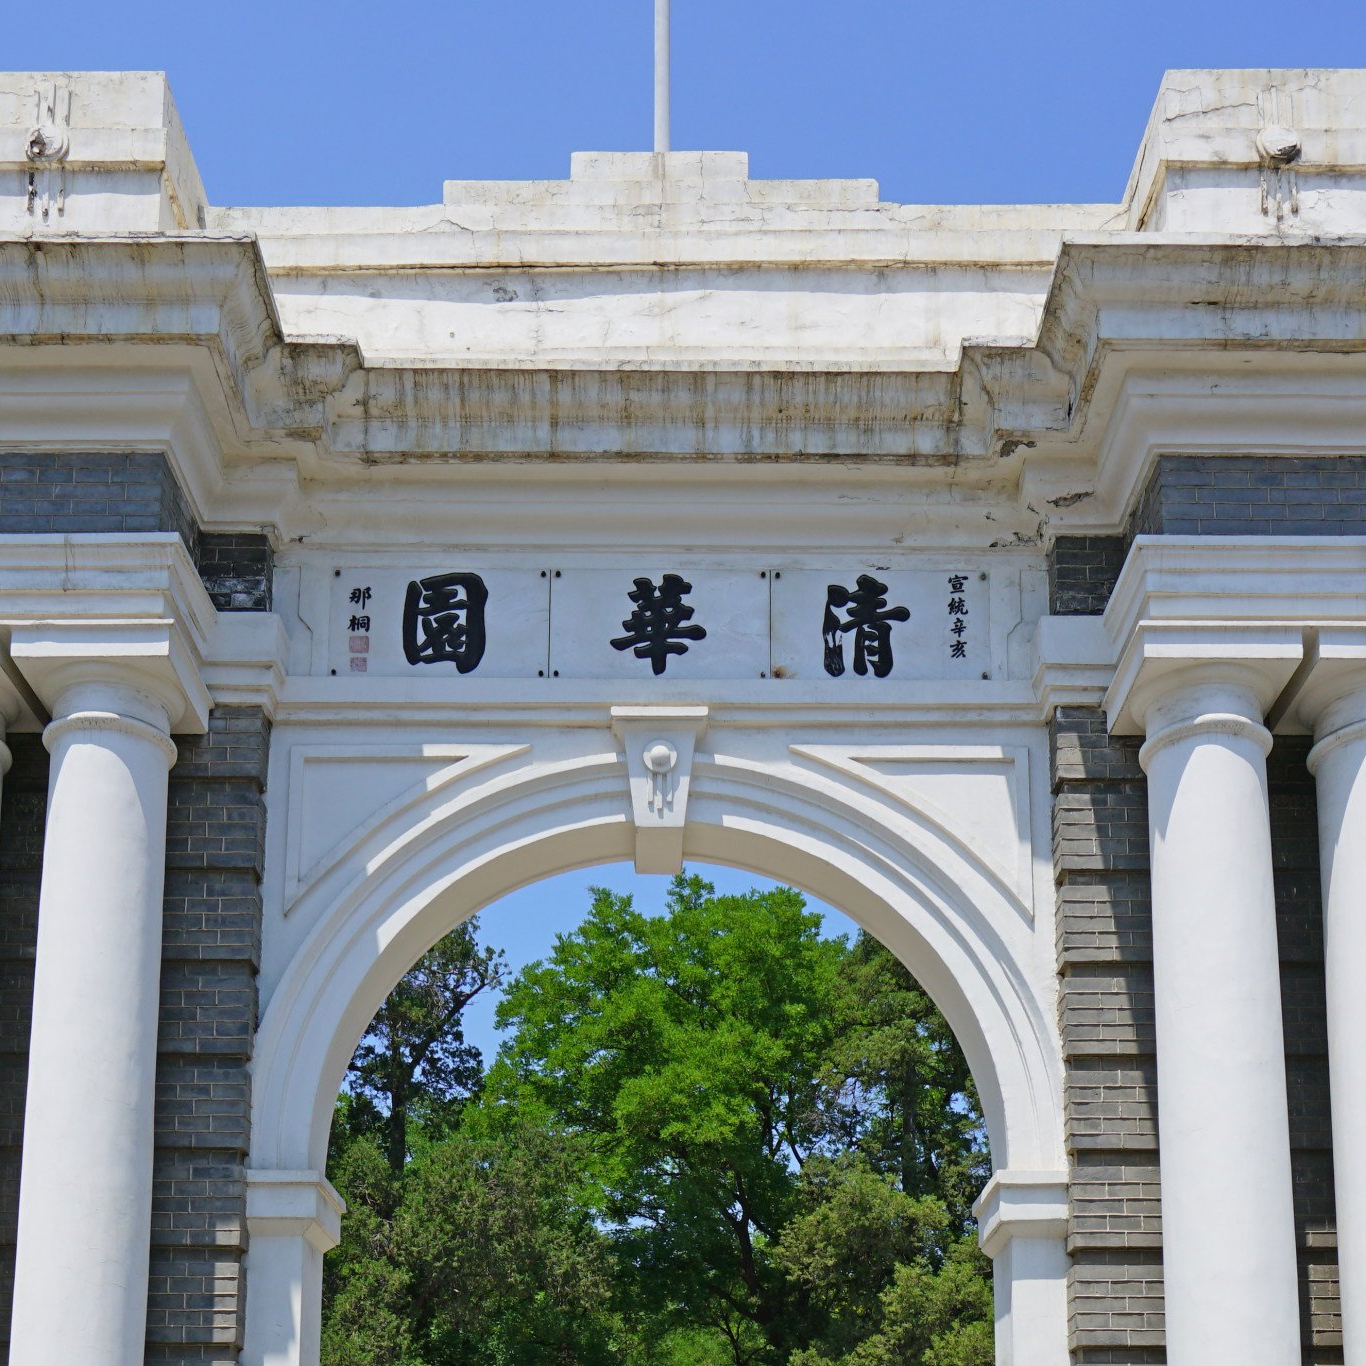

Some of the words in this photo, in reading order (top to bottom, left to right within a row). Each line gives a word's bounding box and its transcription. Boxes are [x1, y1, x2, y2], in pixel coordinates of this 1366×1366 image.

[347, 586, 372, 632] 那桐
[402, 571, 911, 677] 清華園
[947, 574, 969, 658] 宣統辛亥
